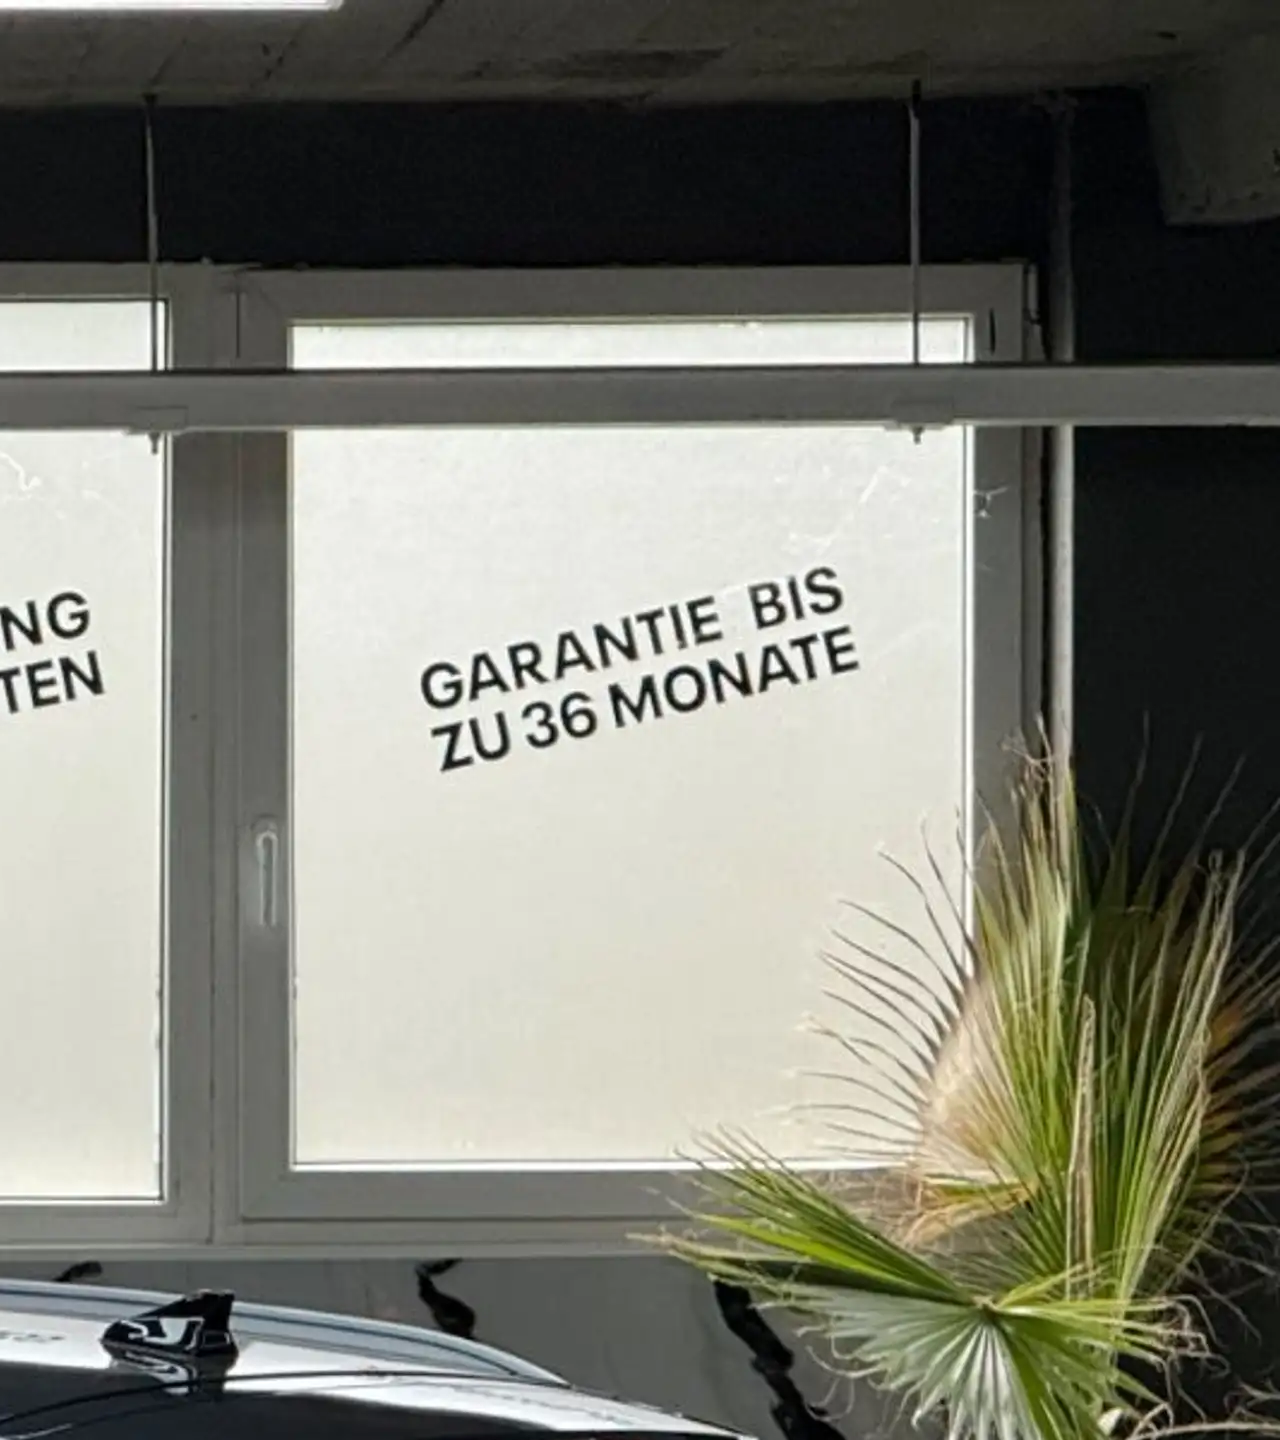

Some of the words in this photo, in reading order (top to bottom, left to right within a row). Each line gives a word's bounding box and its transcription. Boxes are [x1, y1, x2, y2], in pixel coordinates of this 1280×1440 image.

[421, 596, 722, 709] GARANTIE
[749, 568, 842, 629] BIS
[431, 712, 510, 771] ZU
[522, 692, 597, 748] 36
[609, 626, 858, 728] MONATE
